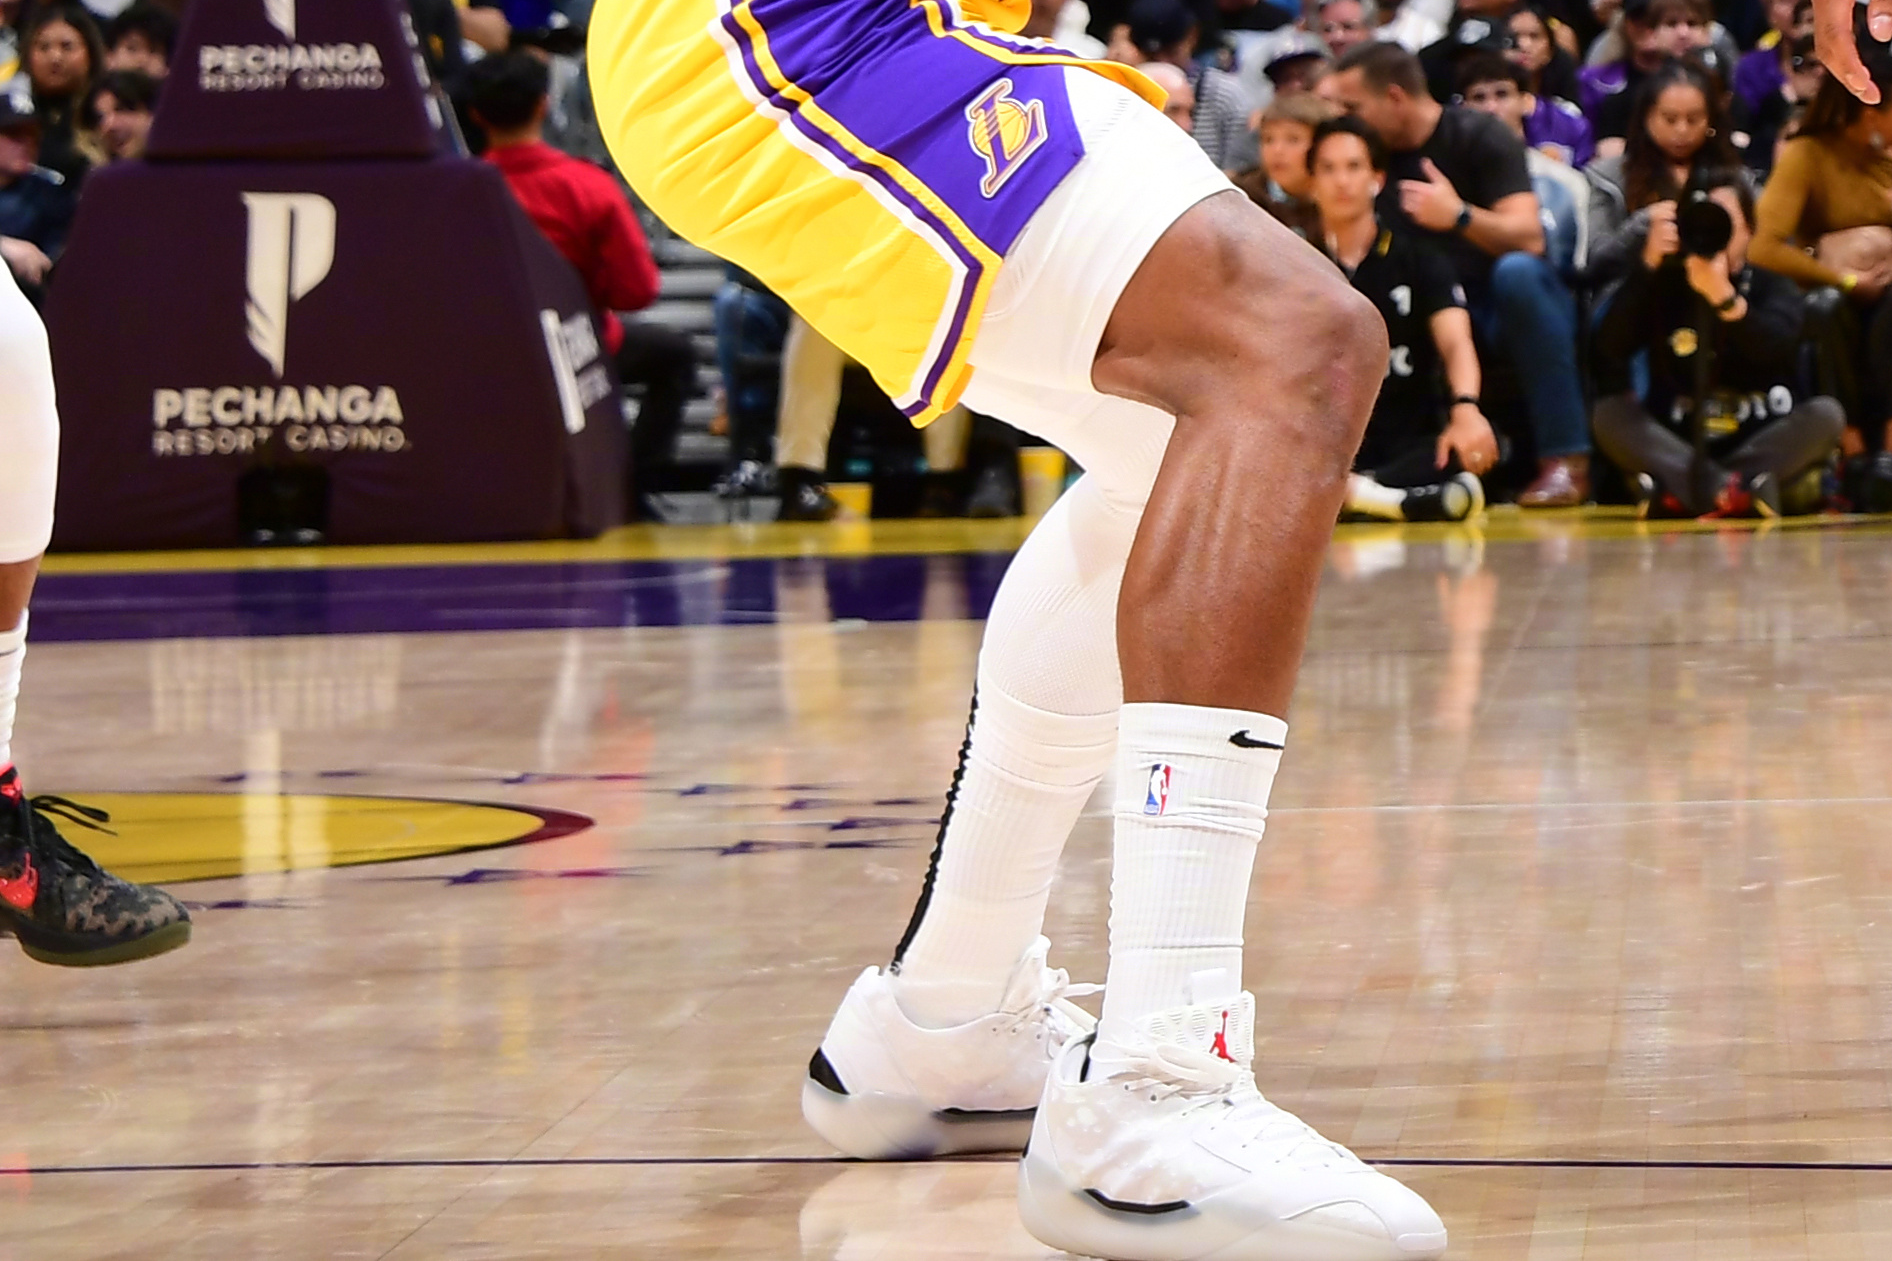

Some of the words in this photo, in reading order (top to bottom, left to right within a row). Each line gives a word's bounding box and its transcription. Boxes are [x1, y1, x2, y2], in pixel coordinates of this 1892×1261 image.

[199, 43, 383, 74] PECHANGA
[152, 384, 404, 428] PECHANGA
[152, 426, 272, 457] RESORT
[285, 424, 406, 453] CASINO
